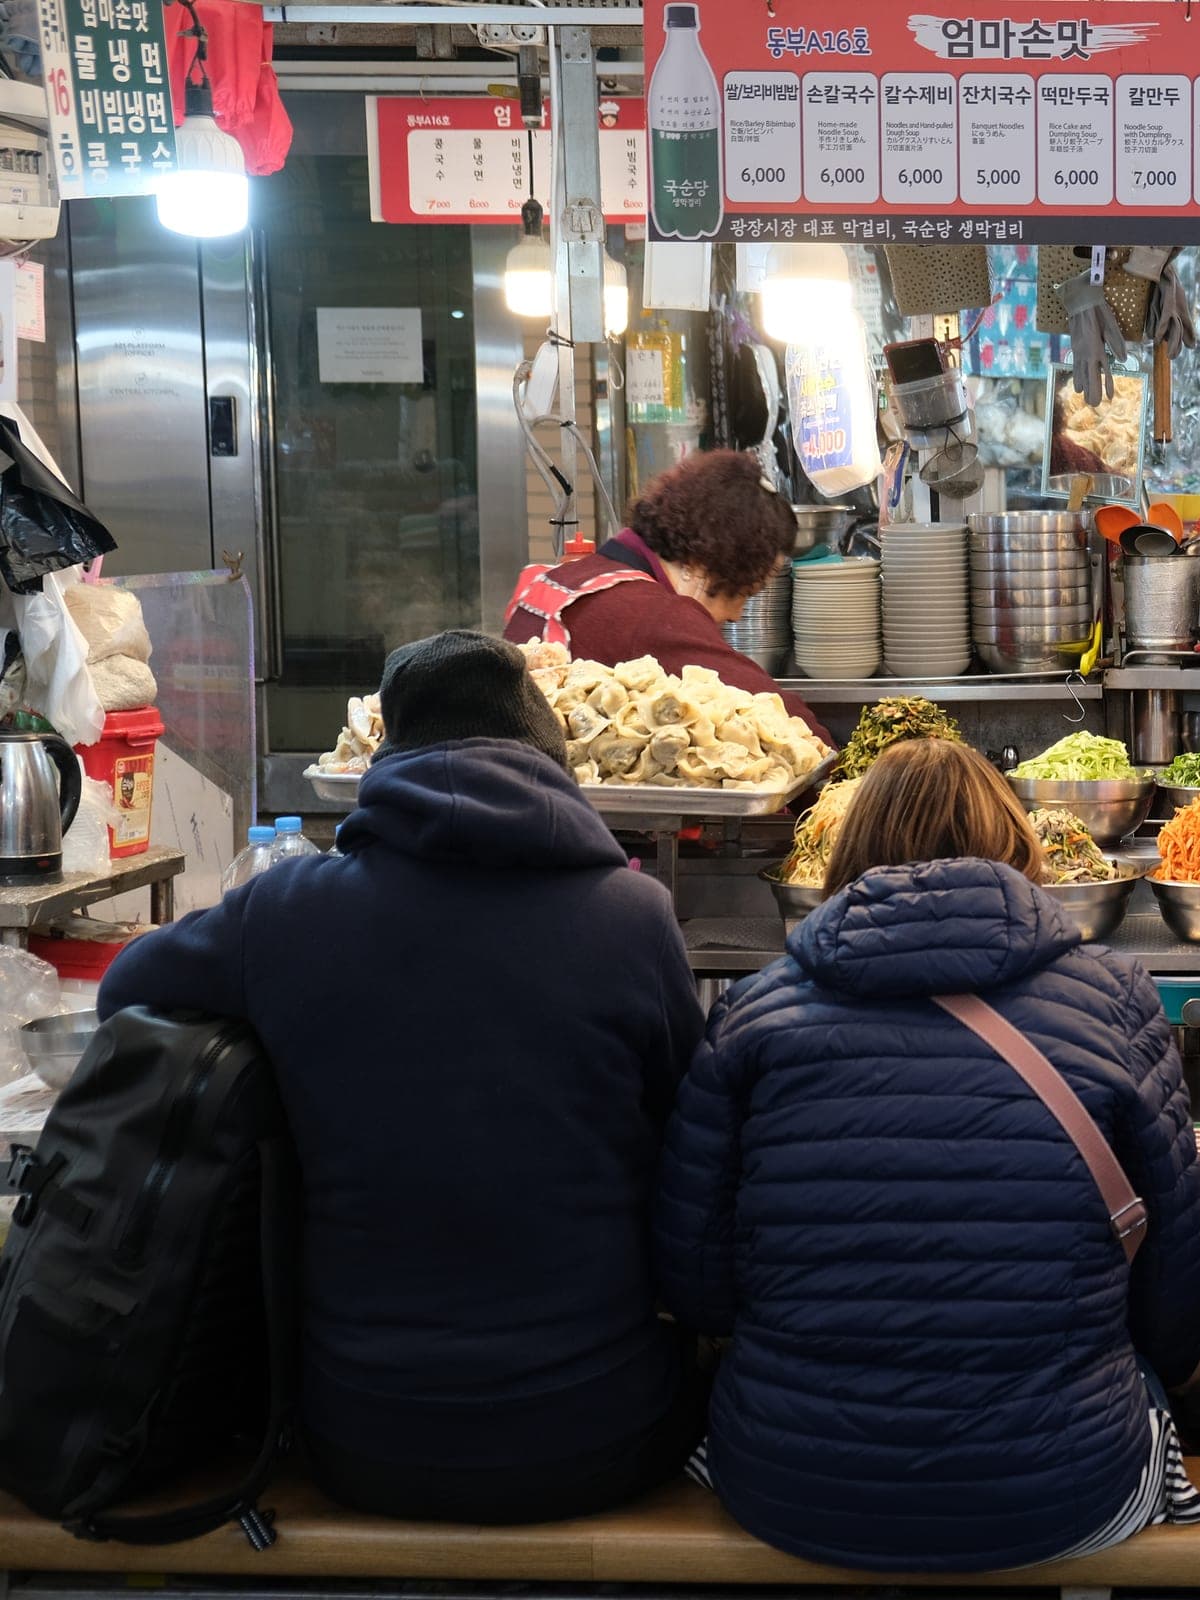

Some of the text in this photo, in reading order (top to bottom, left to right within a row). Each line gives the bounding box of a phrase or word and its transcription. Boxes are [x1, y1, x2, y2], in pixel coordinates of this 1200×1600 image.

[80, 0, 149, 33] 엄마손맛
[767, 28, 871, 58] 동부A16호
[941, 19, 1093, 60] 엄마손맛
[48, 68, 70, 117] 16
[726, 84, 799, 101] 쌀/보리비빔밥
[806, 84, 876, 104] 손칼국수
[884, 85, 953, 105] 칼수제비
[962, 86, 1032, 105] 잔치국수
[1041, 87, 1110, 106] 떡만두국
[1129, 87, 1180, 107] 칼만두
[80, 89, 169, 135] 비빔냉면
[406, 114, 451, 127] 동부A16호
[730, 120, 796, 129] Rice/Barley Bibimbap
[817, 128, 860, 137] Noodle Soup
[886, 129, 920, 137] Dough Soup
[920, 122, 953, 130] Hand-pulled
[971, 122, 1025, 131] Banquet Noodles
[1147, 124, 1163, 132] Soup
[1049, 130, 1097, 139] Dumpling Soup
[1138, 131, 1172, 140] Dumplings
[433, 137, 445, 181] 콩국수
[473, 138, 484, 182] 물냉면
[511, 137, 523, 190] 비빔냉면
[626, 137, 638, 189] 비빔국수
[741, 168, 785, 185] 6,000
[820, 168, 865, 186] 6,000
[898, 169, 943, 187] 6,000
[976, 169, 1021, 188] 5,000
[1054, 170, 1099, 188] 6,000
[1133, 171, 1177, 189] 7,000
[663, 179, 709, 197] 국순당
[730, 219, 1024, 240] 광장시장 대표 막걸리, 국순당 생막걸리
